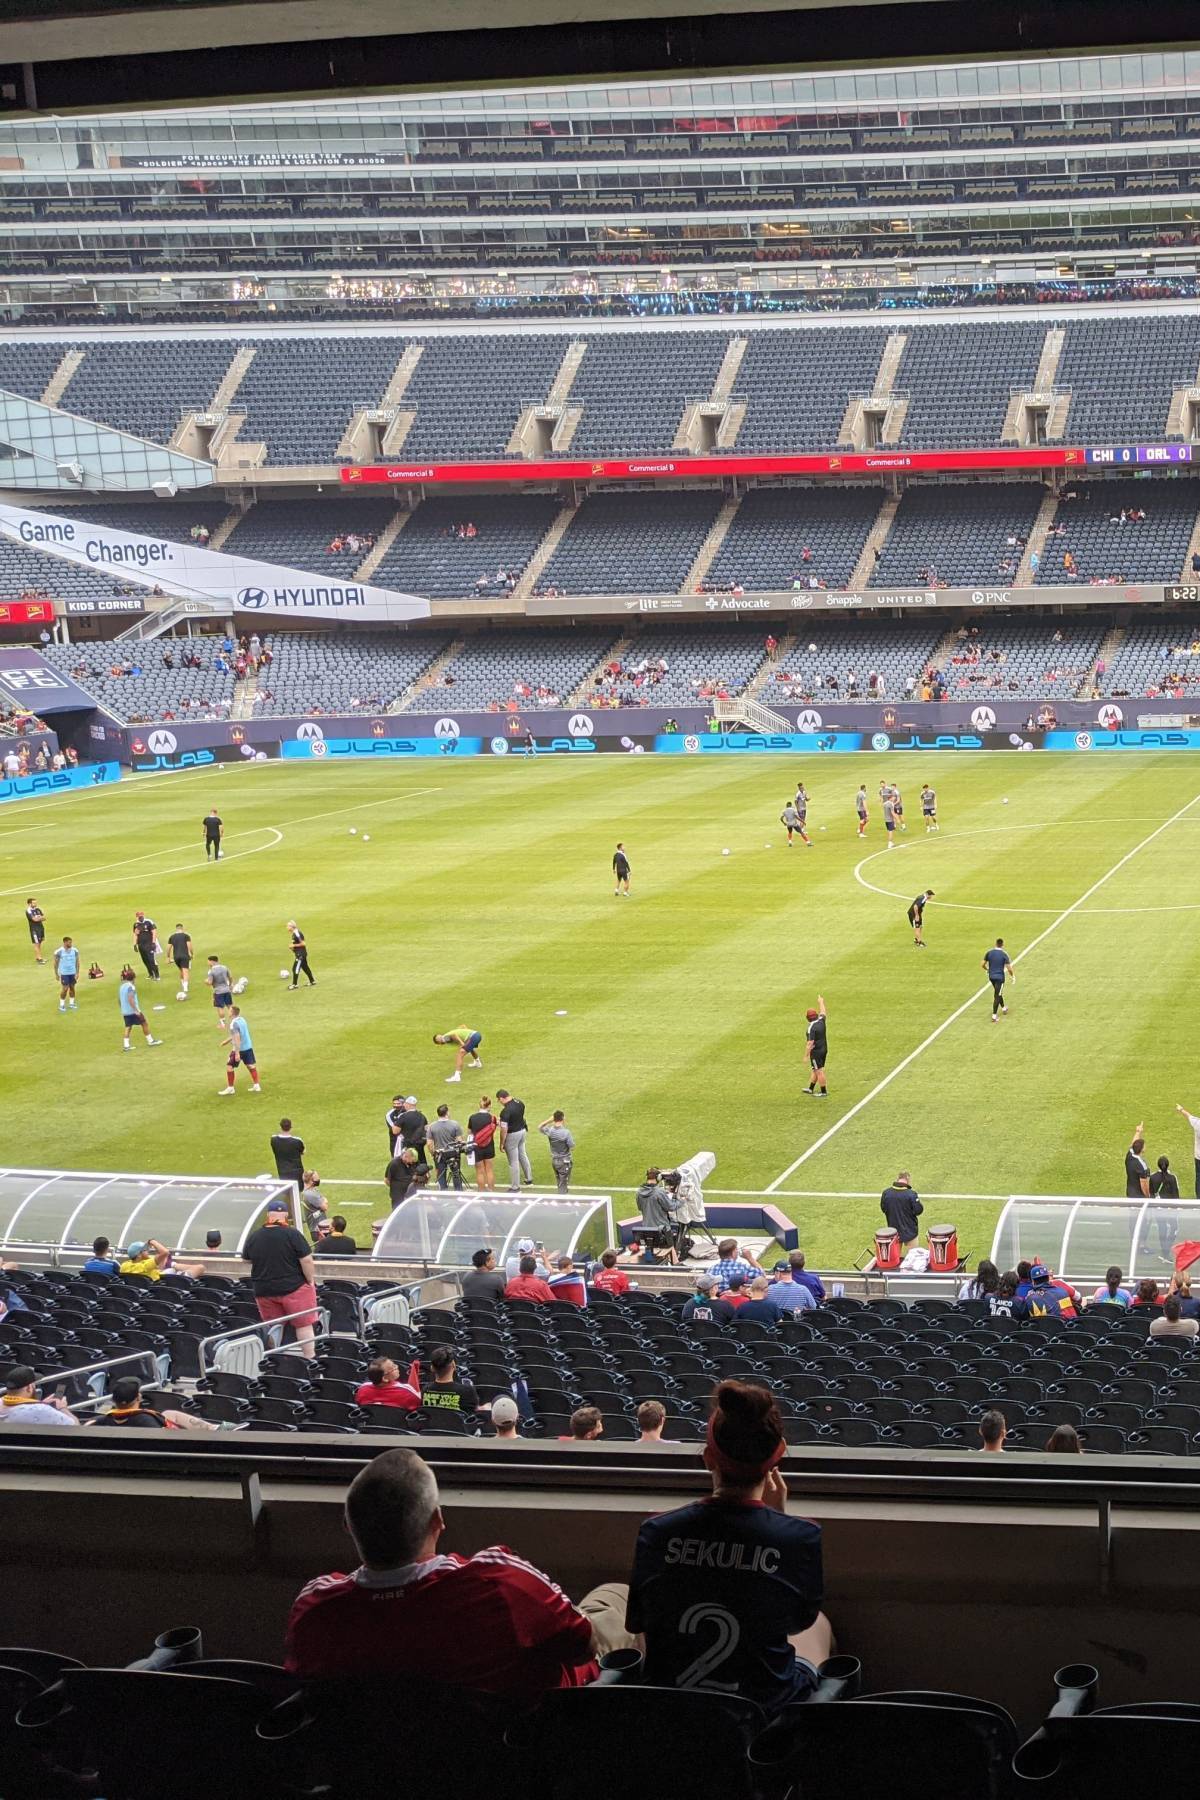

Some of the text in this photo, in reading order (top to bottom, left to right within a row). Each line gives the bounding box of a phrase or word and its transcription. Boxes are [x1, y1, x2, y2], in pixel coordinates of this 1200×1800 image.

[1092, 449, 1130, 462] CHI 0
[1146, 447, 1186, 460] ORL 0
[628, 464, 669, 472] Commercial
[866, 458, 905, 467] Commercial
[387, 469, 424, 479] Commercial
[19, 520, 75, 542] Game
[85, 540, 174, 566] Changer.
[274, 587, 366, 607] HYUNDAI
[877, 595, 923, 604] UNITED
[985, 592, 1012, 603] PNC
[1172, 587, 1197, 600] 6:22
[69, 600, 142, 611] KIDS CORNER
[639, 599, 659, 611] Lite
[720, 597, 771, 609] Advocate
[826, 594, 863, 607] Snapple
[703, 736, 793, 749] JLAB
[893, 735, 983, 749] JLAB
[1095, 733, 1189, 746] JLAB
[331, 740, 418, 753] JLAB
[137, 749, 215, 770] JLAB
[990, 1297, 1013, 1307] BLANCO
[664, 1537, 781, 1574] SEKULIC
[675, 1602, 741, 1692] 2
